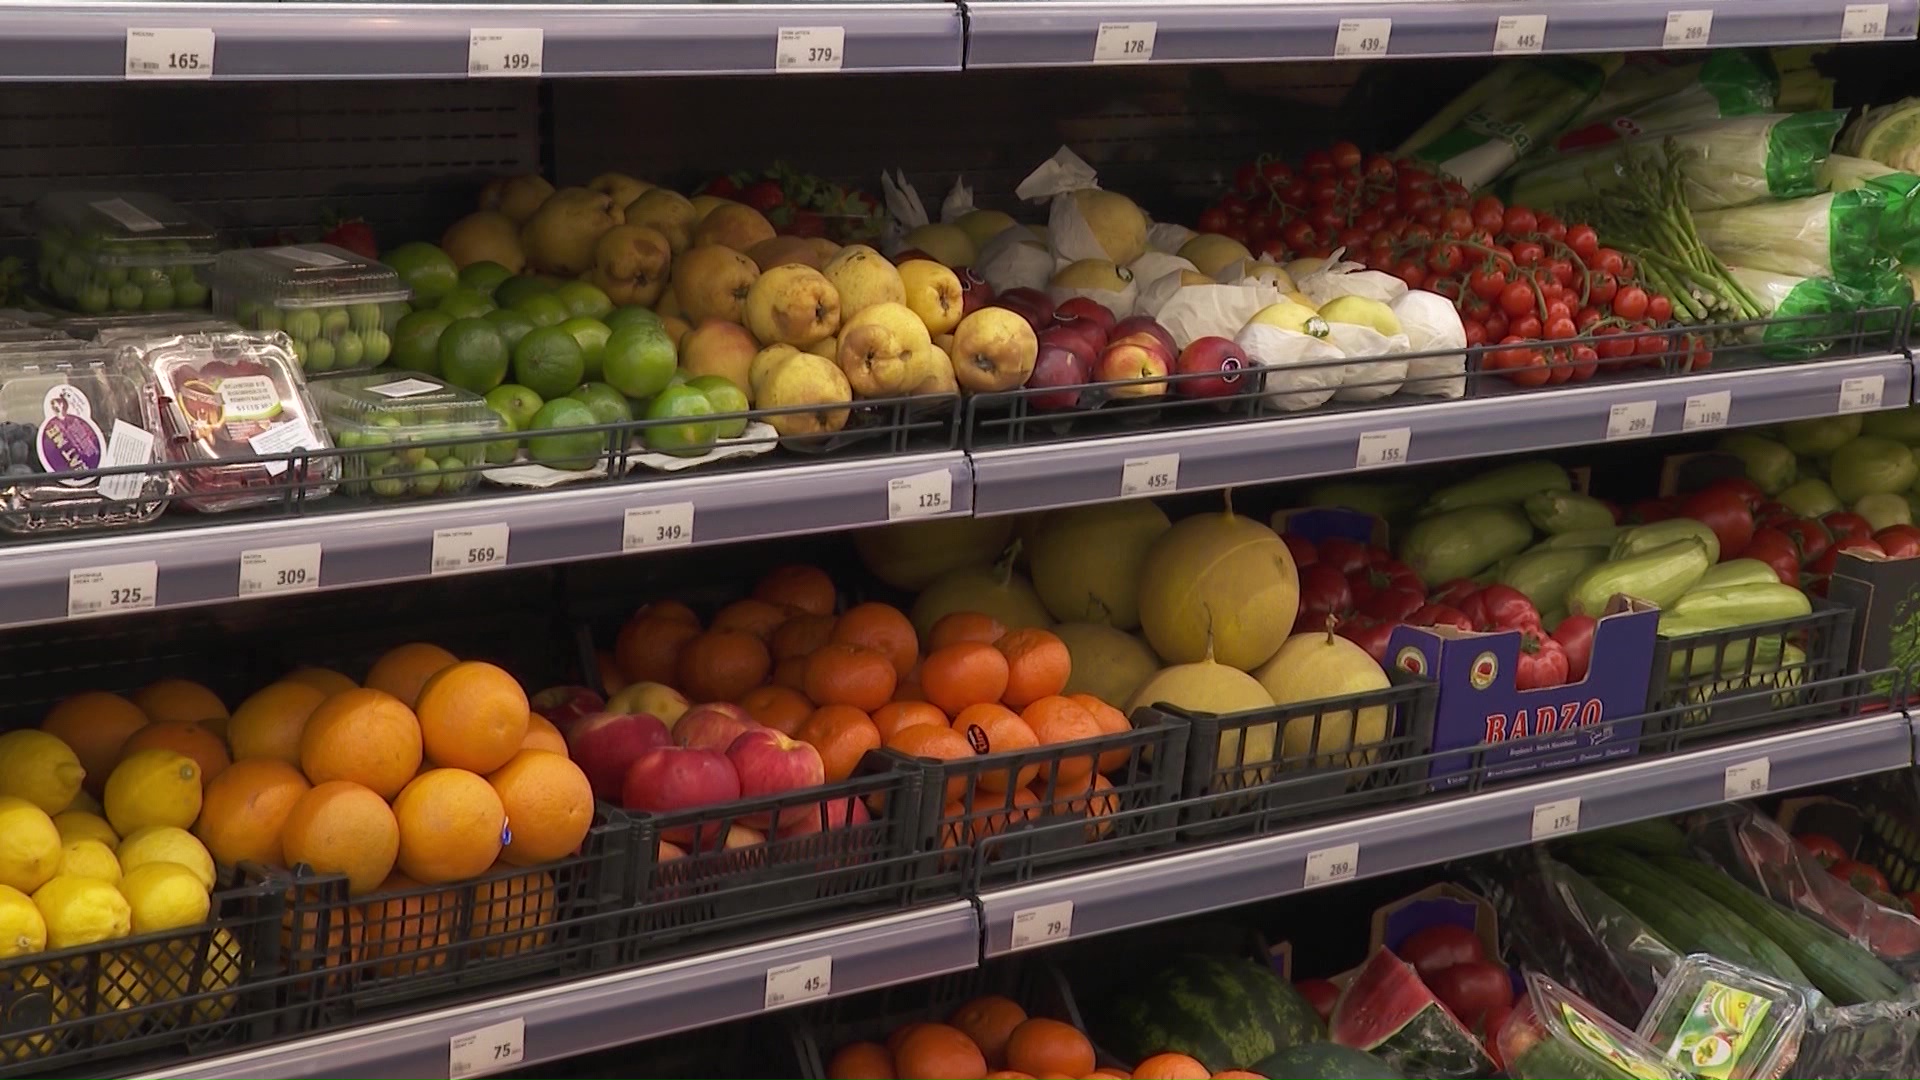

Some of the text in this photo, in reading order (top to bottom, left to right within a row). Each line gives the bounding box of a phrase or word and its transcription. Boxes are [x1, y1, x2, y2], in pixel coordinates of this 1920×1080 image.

[1123, 40, 1144, 53] 178
[1360, 38, 1380, 51] 439
[1517, 34, 1536, 48] 445
[168, 52, 199, 69] 165
[503, 54, 530, 69] 199
[808, 47, 832, 62] 379
[46, 425, 69, 449] ME
[1381, 448, 1400, 461] 155
[1147, 473, 1168, 487] 455
[919, 493, 941, 507] 125
[656, 525, 681, 541] 349
[467, 547, 495, 563] 569
[277, 568, 306, 585] 309
[110, 587, 142, 605] 325
[1554, 815, 1571, 829] 175
[1330, 862, 1349, 877] 269
[1047, 920, 1061, 935] 79
[804, 976, 820, 991] 45
[494, 1042, 511, 1060] 75
